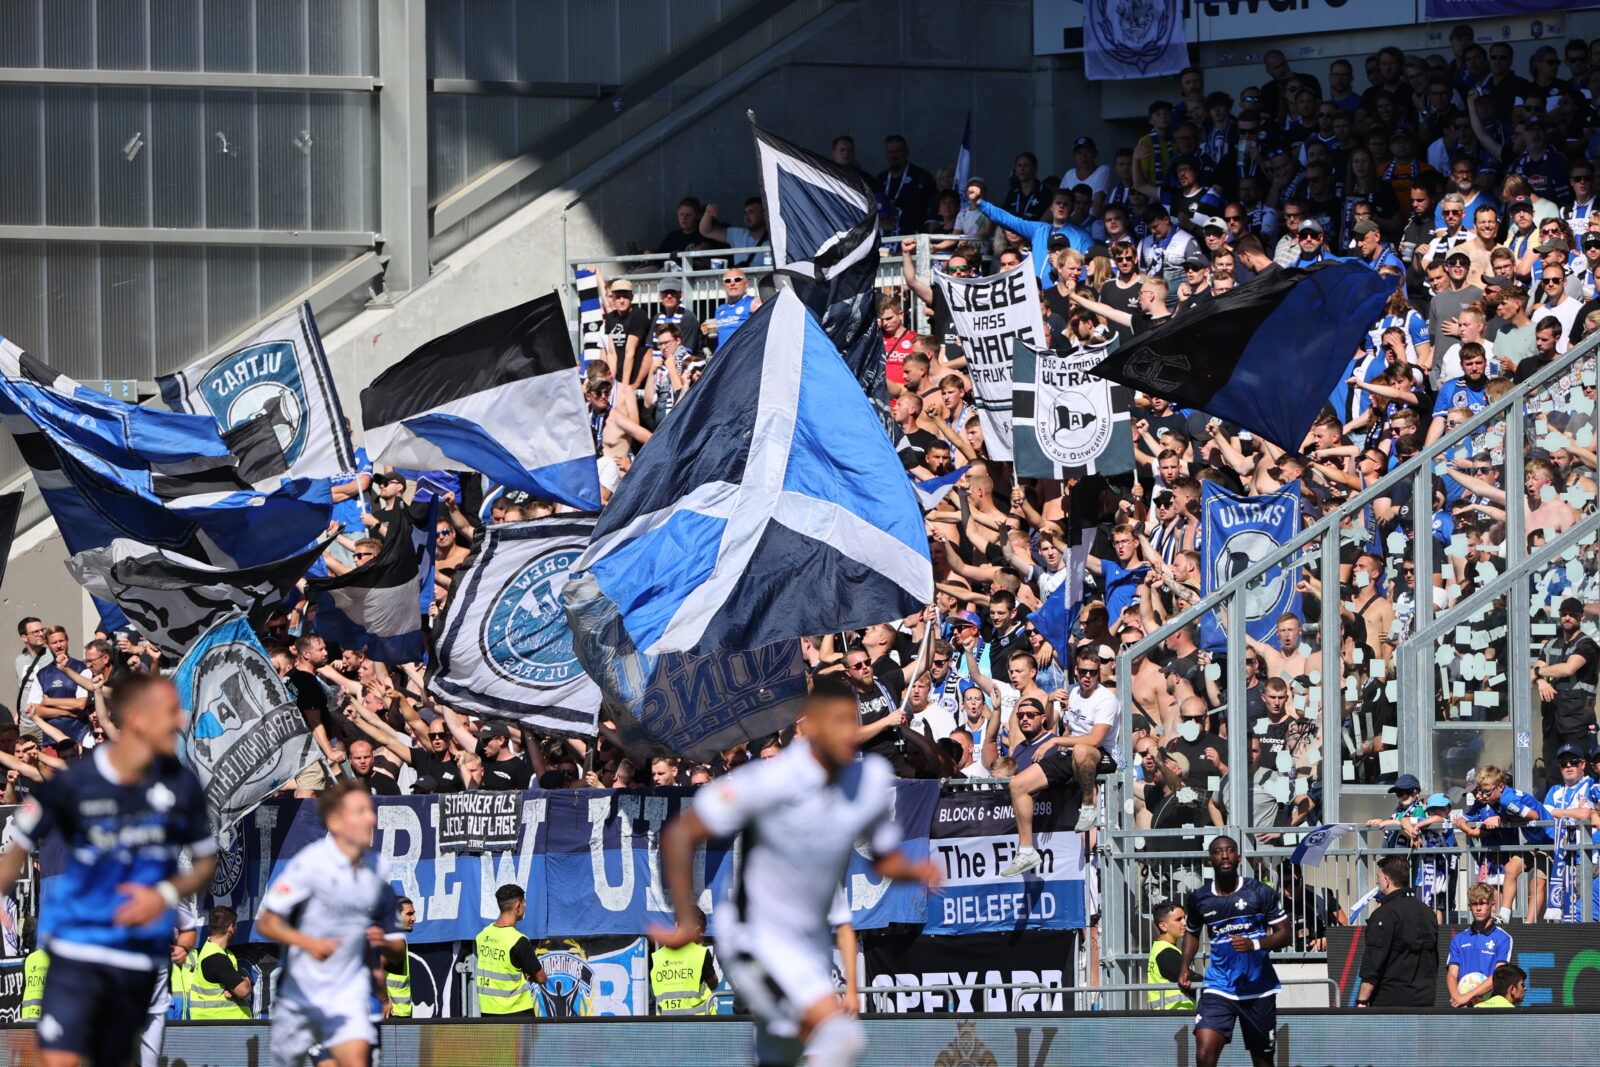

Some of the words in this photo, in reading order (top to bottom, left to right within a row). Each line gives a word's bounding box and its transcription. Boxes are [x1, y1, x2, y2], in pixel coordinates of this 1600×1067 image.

[947, 271, 1026, 312] LIEBE
[973, 313, 1006, 330] HASS
[1042, 358, 1057, 370] DSC
[1059, 357, 1101, 370] Arminia
[1071, 414, 1080, 426] A
[1219, 502, 1286, 528] ULTRAS
[445, 791, 493, 814] STÄRKER
[494, 794, 516, 814] ALS
[939, 807, 976, 822] BLOCK
[978, 808, 985, 820] 6
[993, 806, 1015, 819] SIN
[1033, 802, 1052, 815] 998
[443, 816, 465, 837] JEDE
[467, 815, 517, 836] AUFLAGE
[370, 798, 547, 923] REW
[938, 845, 986, 879] The
[992, 842, 1054, 876] Fim
[943, 892, 1056, 924] BIELEFELD
[27, 975, 45, 988] RDN
[656, 968, 694, 983] ORDNER
[665, 999, 681, 1009] 157
